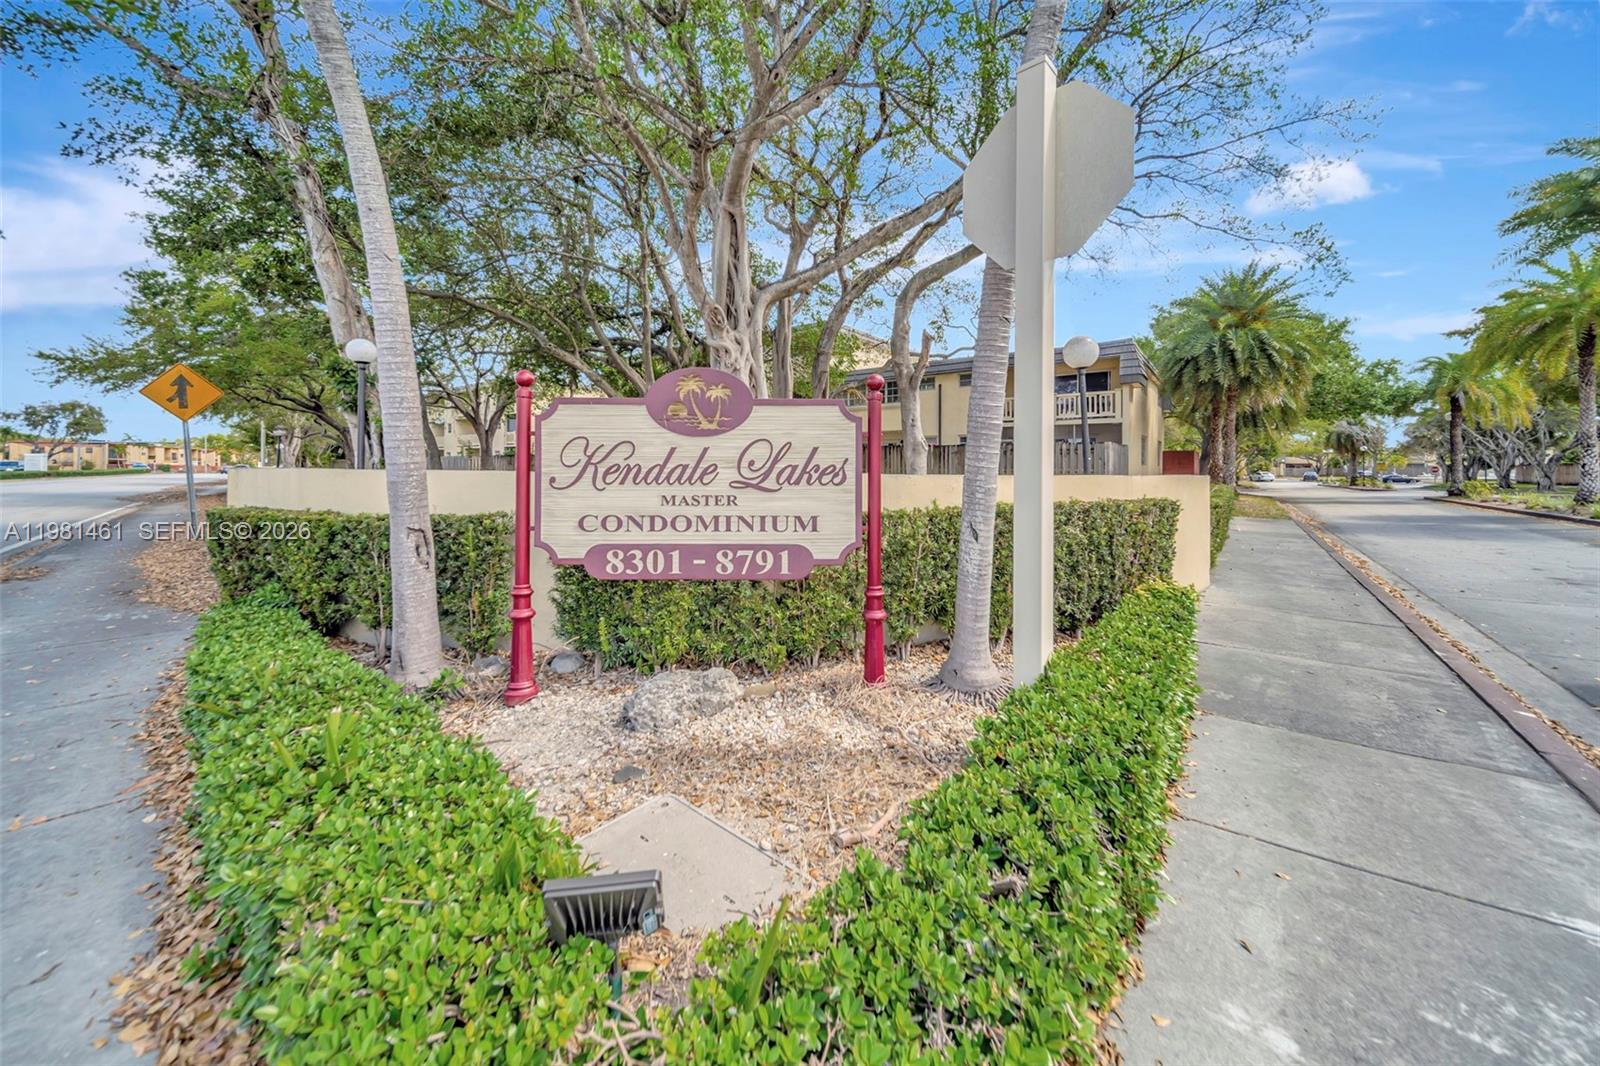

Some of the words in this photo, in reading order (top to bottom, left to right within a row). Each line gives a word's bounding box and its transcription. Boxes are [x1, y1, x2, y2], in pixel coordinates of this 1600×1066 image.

[550, 435, 720, 492] Kendale
[728, 438, 849, 493] Lakes
[660, 494, 739, 507] MASTER
[577, 514, 820, 533] CONDOMINIUM
[605, 549, 682, 575] 8301
[715, 549, 792, 575] 8791
